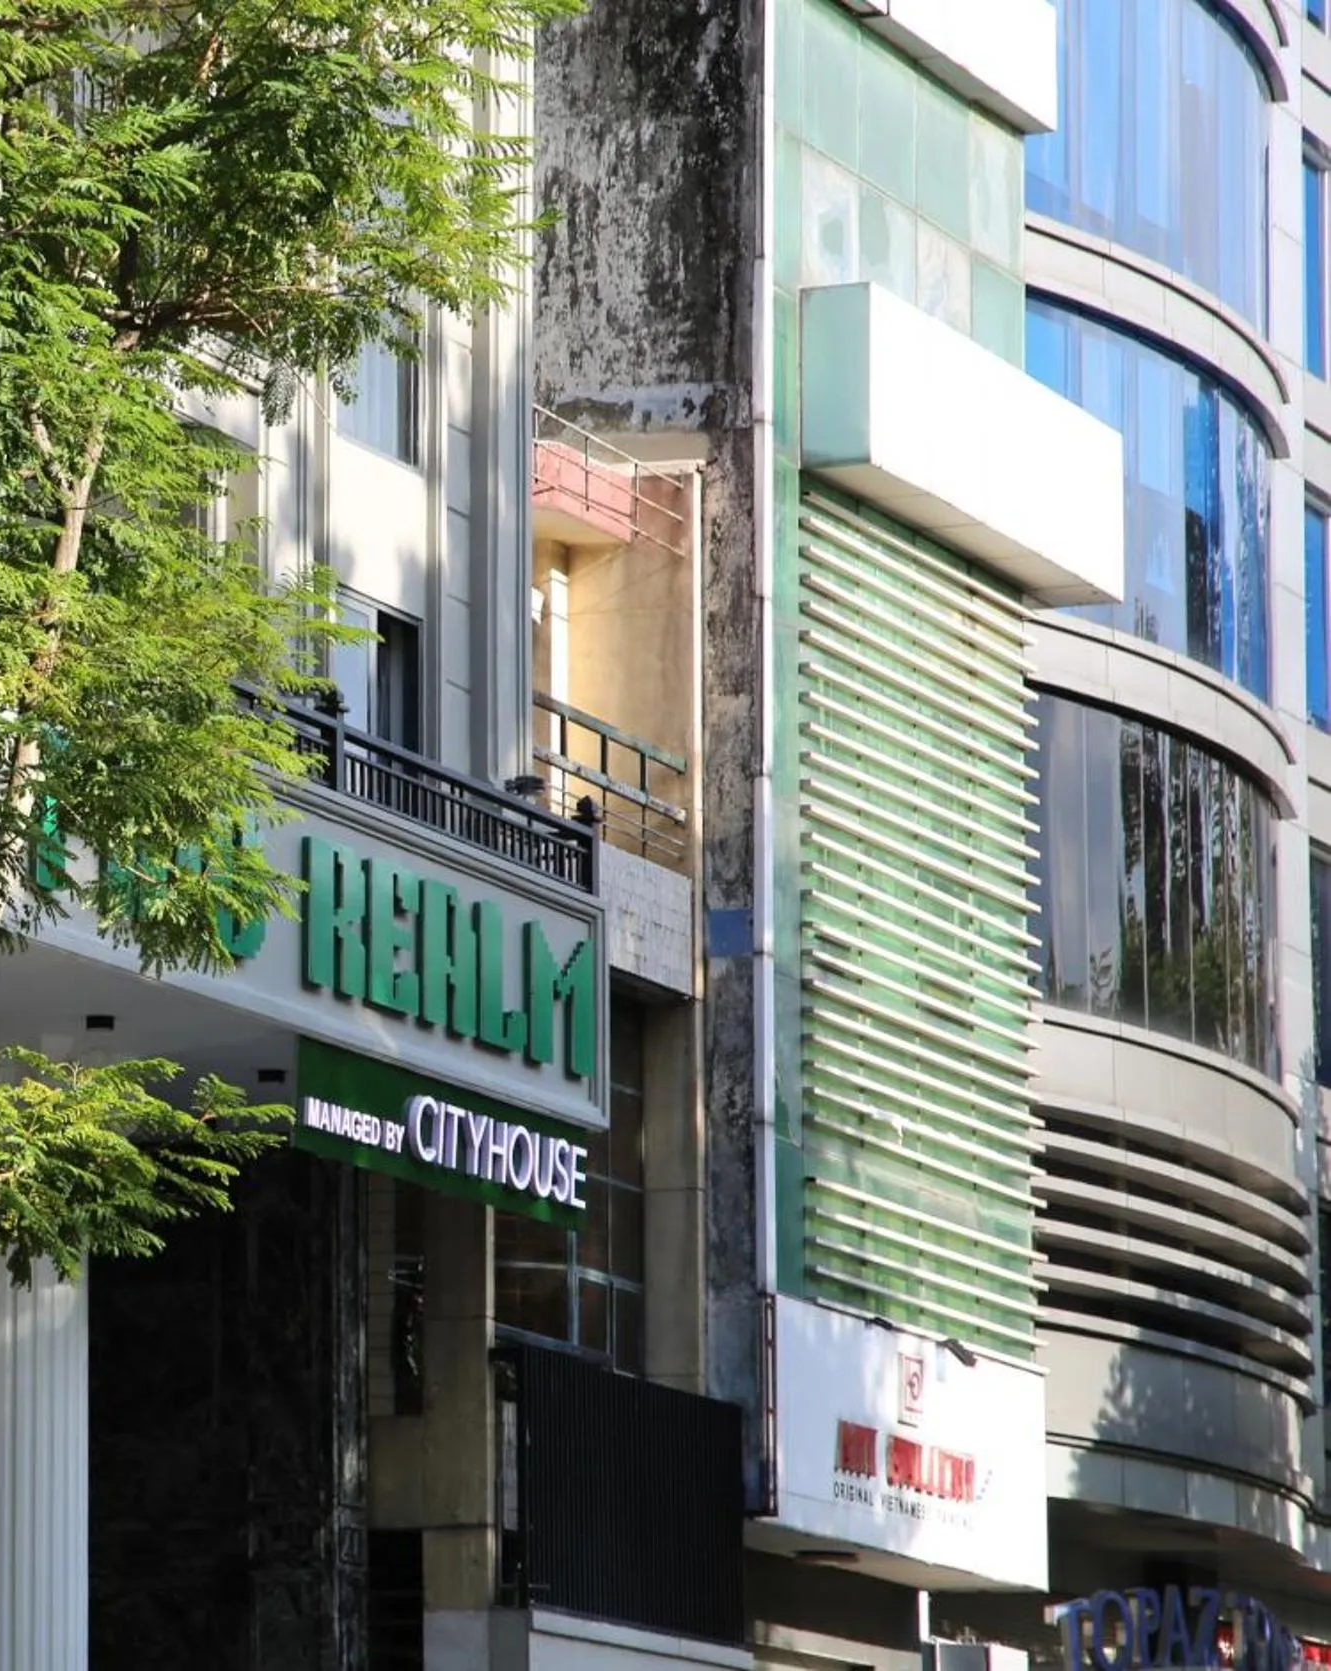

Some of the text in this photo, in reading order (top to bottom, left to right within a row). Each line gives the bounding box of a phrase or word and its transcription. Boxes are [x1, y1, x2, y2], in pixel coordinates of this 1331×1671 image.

[301, 836, 596, 1080] REALM
[303, 1095, 588, 1209] MANAGED BY CITYHOUSE
[833, 1481, 874, 1507] ORIGINAL
[1044, 1584, 1225, 1671] TOPAZ
